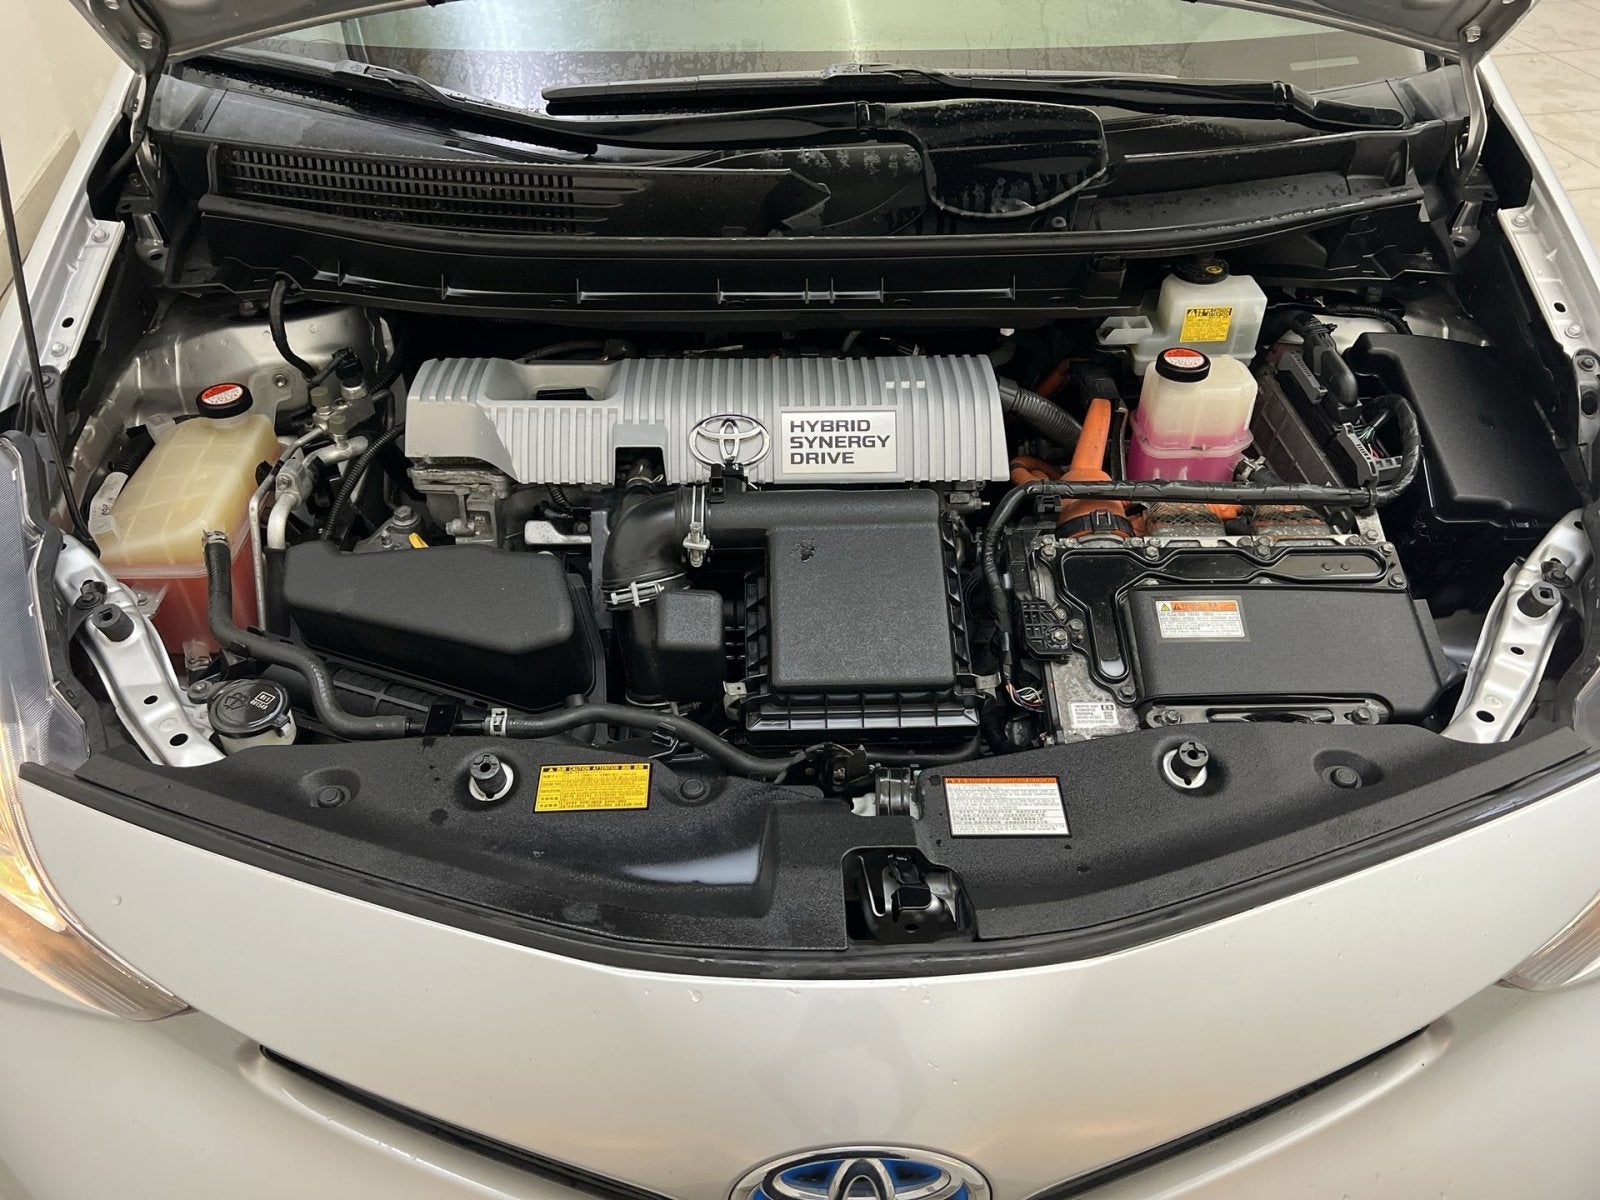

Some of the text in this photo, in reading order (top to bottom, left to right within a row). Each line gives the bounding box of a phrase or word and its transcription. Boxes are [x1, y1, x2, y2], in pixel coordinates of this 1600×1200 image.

[790, 420, 871, 432] HYBRID
[790, 435, 891, 448] SYNERGY
[790, 452, 855, 465] DRIVE
